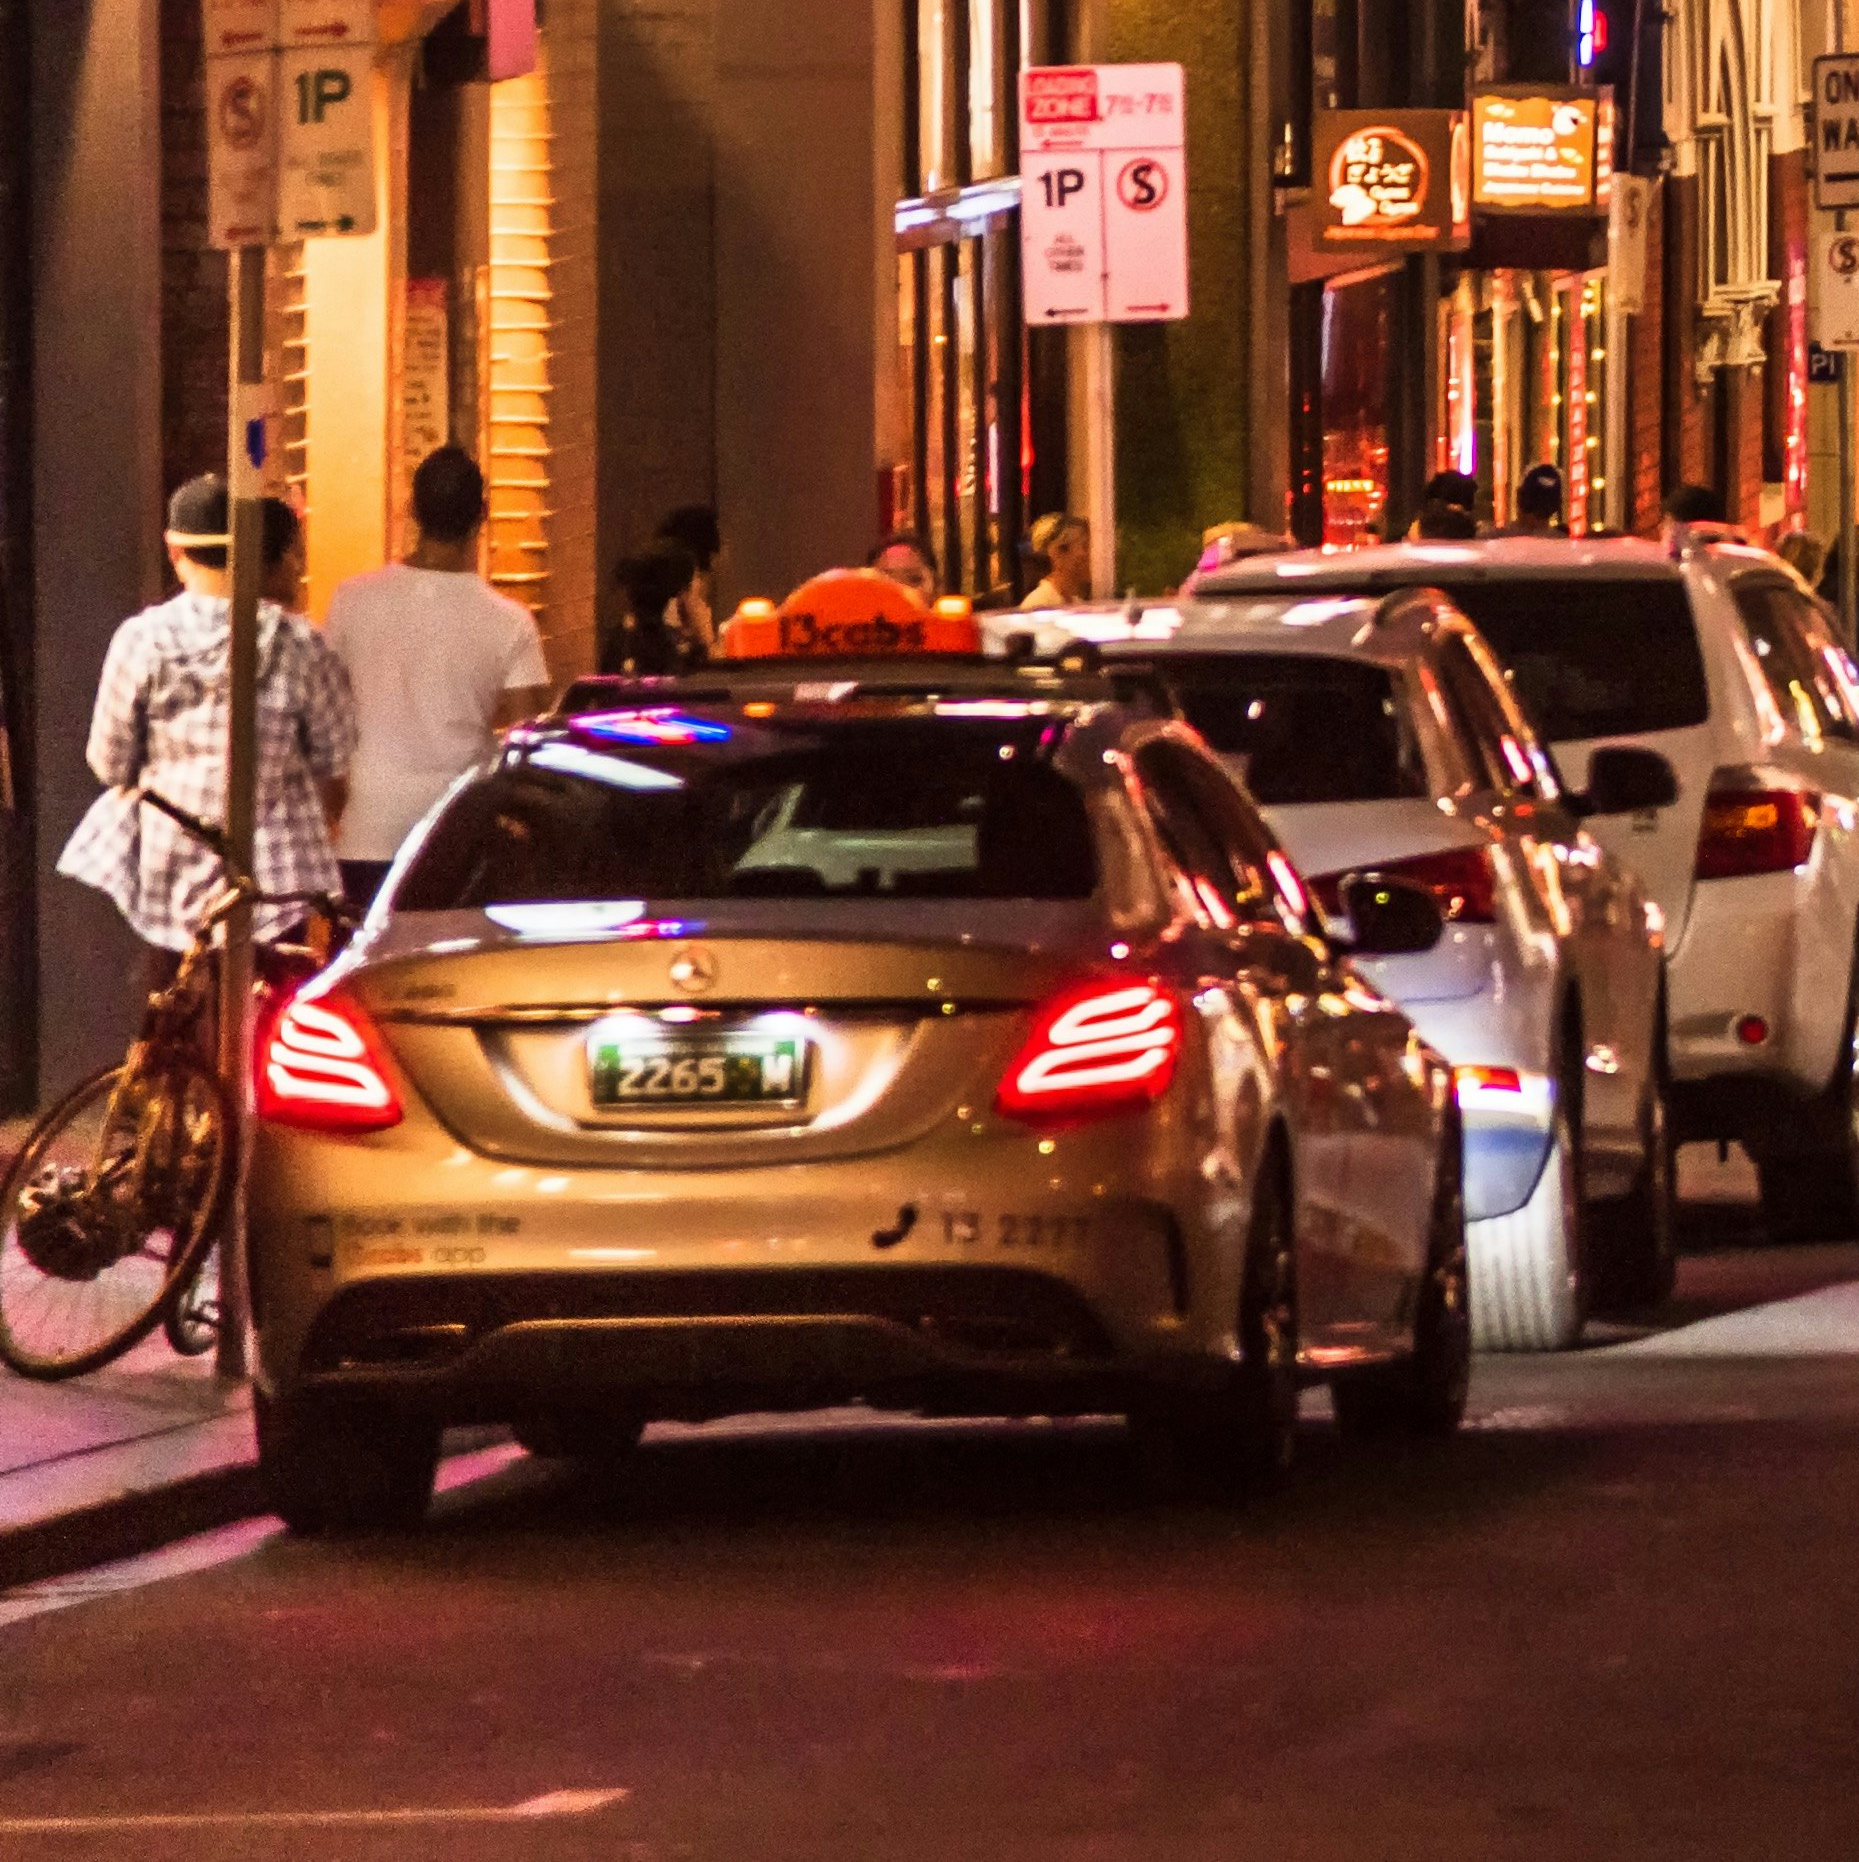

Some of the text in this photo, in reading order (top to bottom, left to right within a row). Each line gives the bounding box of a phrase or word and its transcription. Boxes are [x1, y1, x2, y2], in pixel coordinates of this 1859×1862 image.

[295, 68, 352, 126] 1P
[1031, 97, 1092, 117] ZONE
[1038, 167, 1086, 208] 1P
[779, 612, 929, 649] 13cabs
[618, 1056, 727, 1097] 2265
